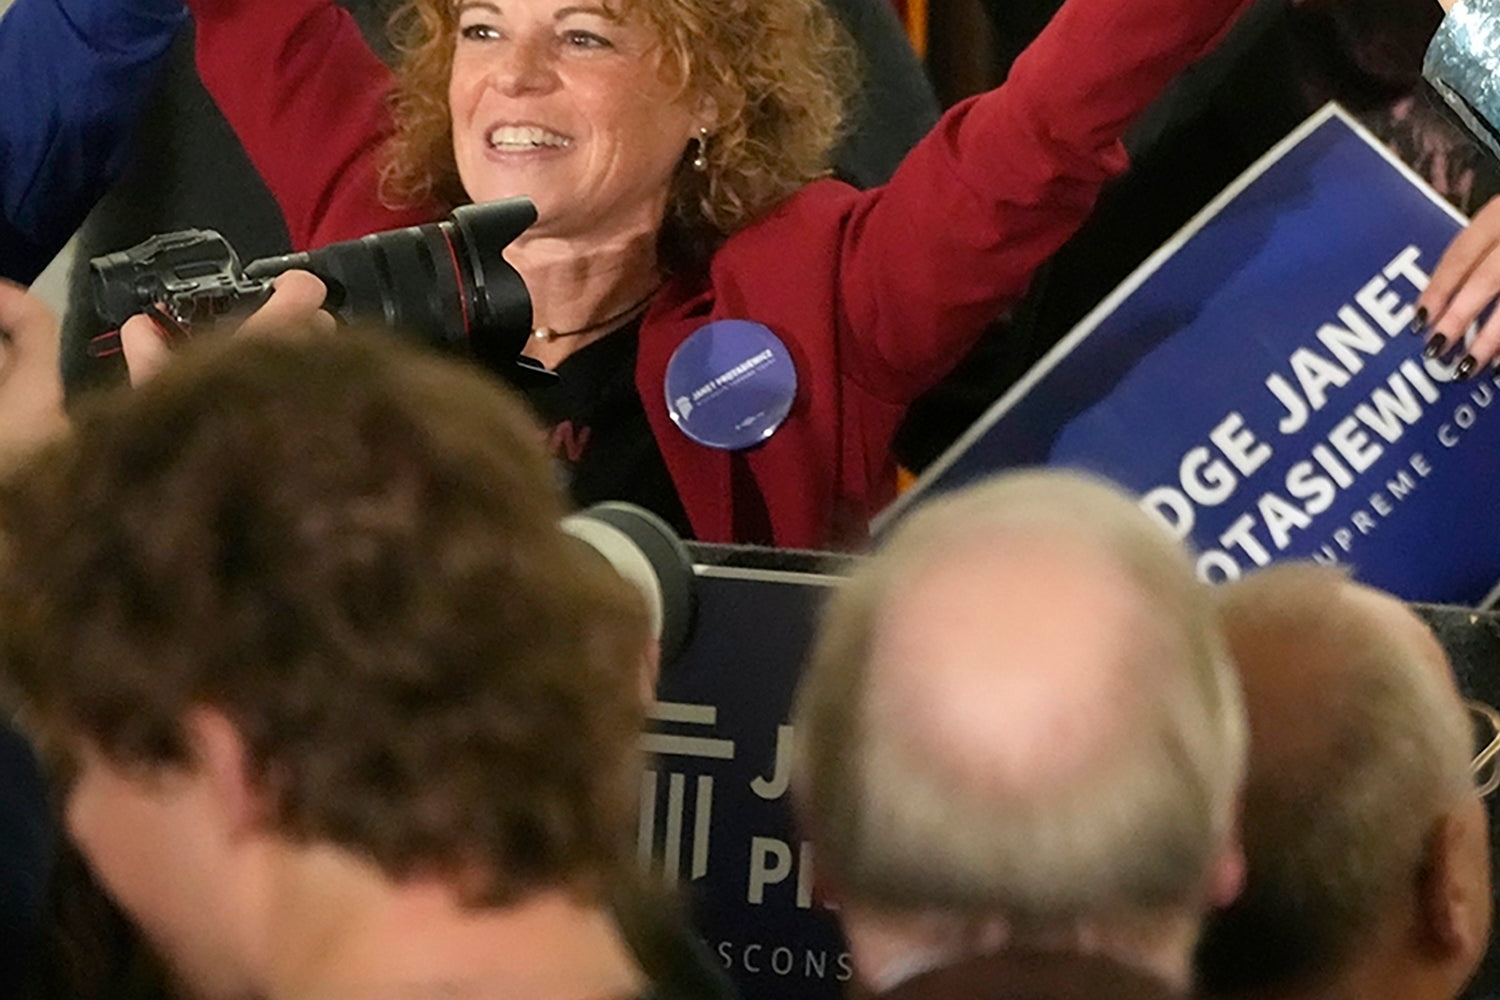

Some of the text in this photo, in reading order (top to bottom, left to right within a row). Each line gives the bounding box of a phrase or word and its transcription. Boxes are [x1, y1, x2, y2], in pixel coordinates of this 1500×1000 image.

[1138, 244, 1432, 541] DGE JANET
[1195, 320, 1478, 586] OTASIEWIC
[1311, 452, 1433, 567] UPREME
[717, 941, 853, 981] SCONS
